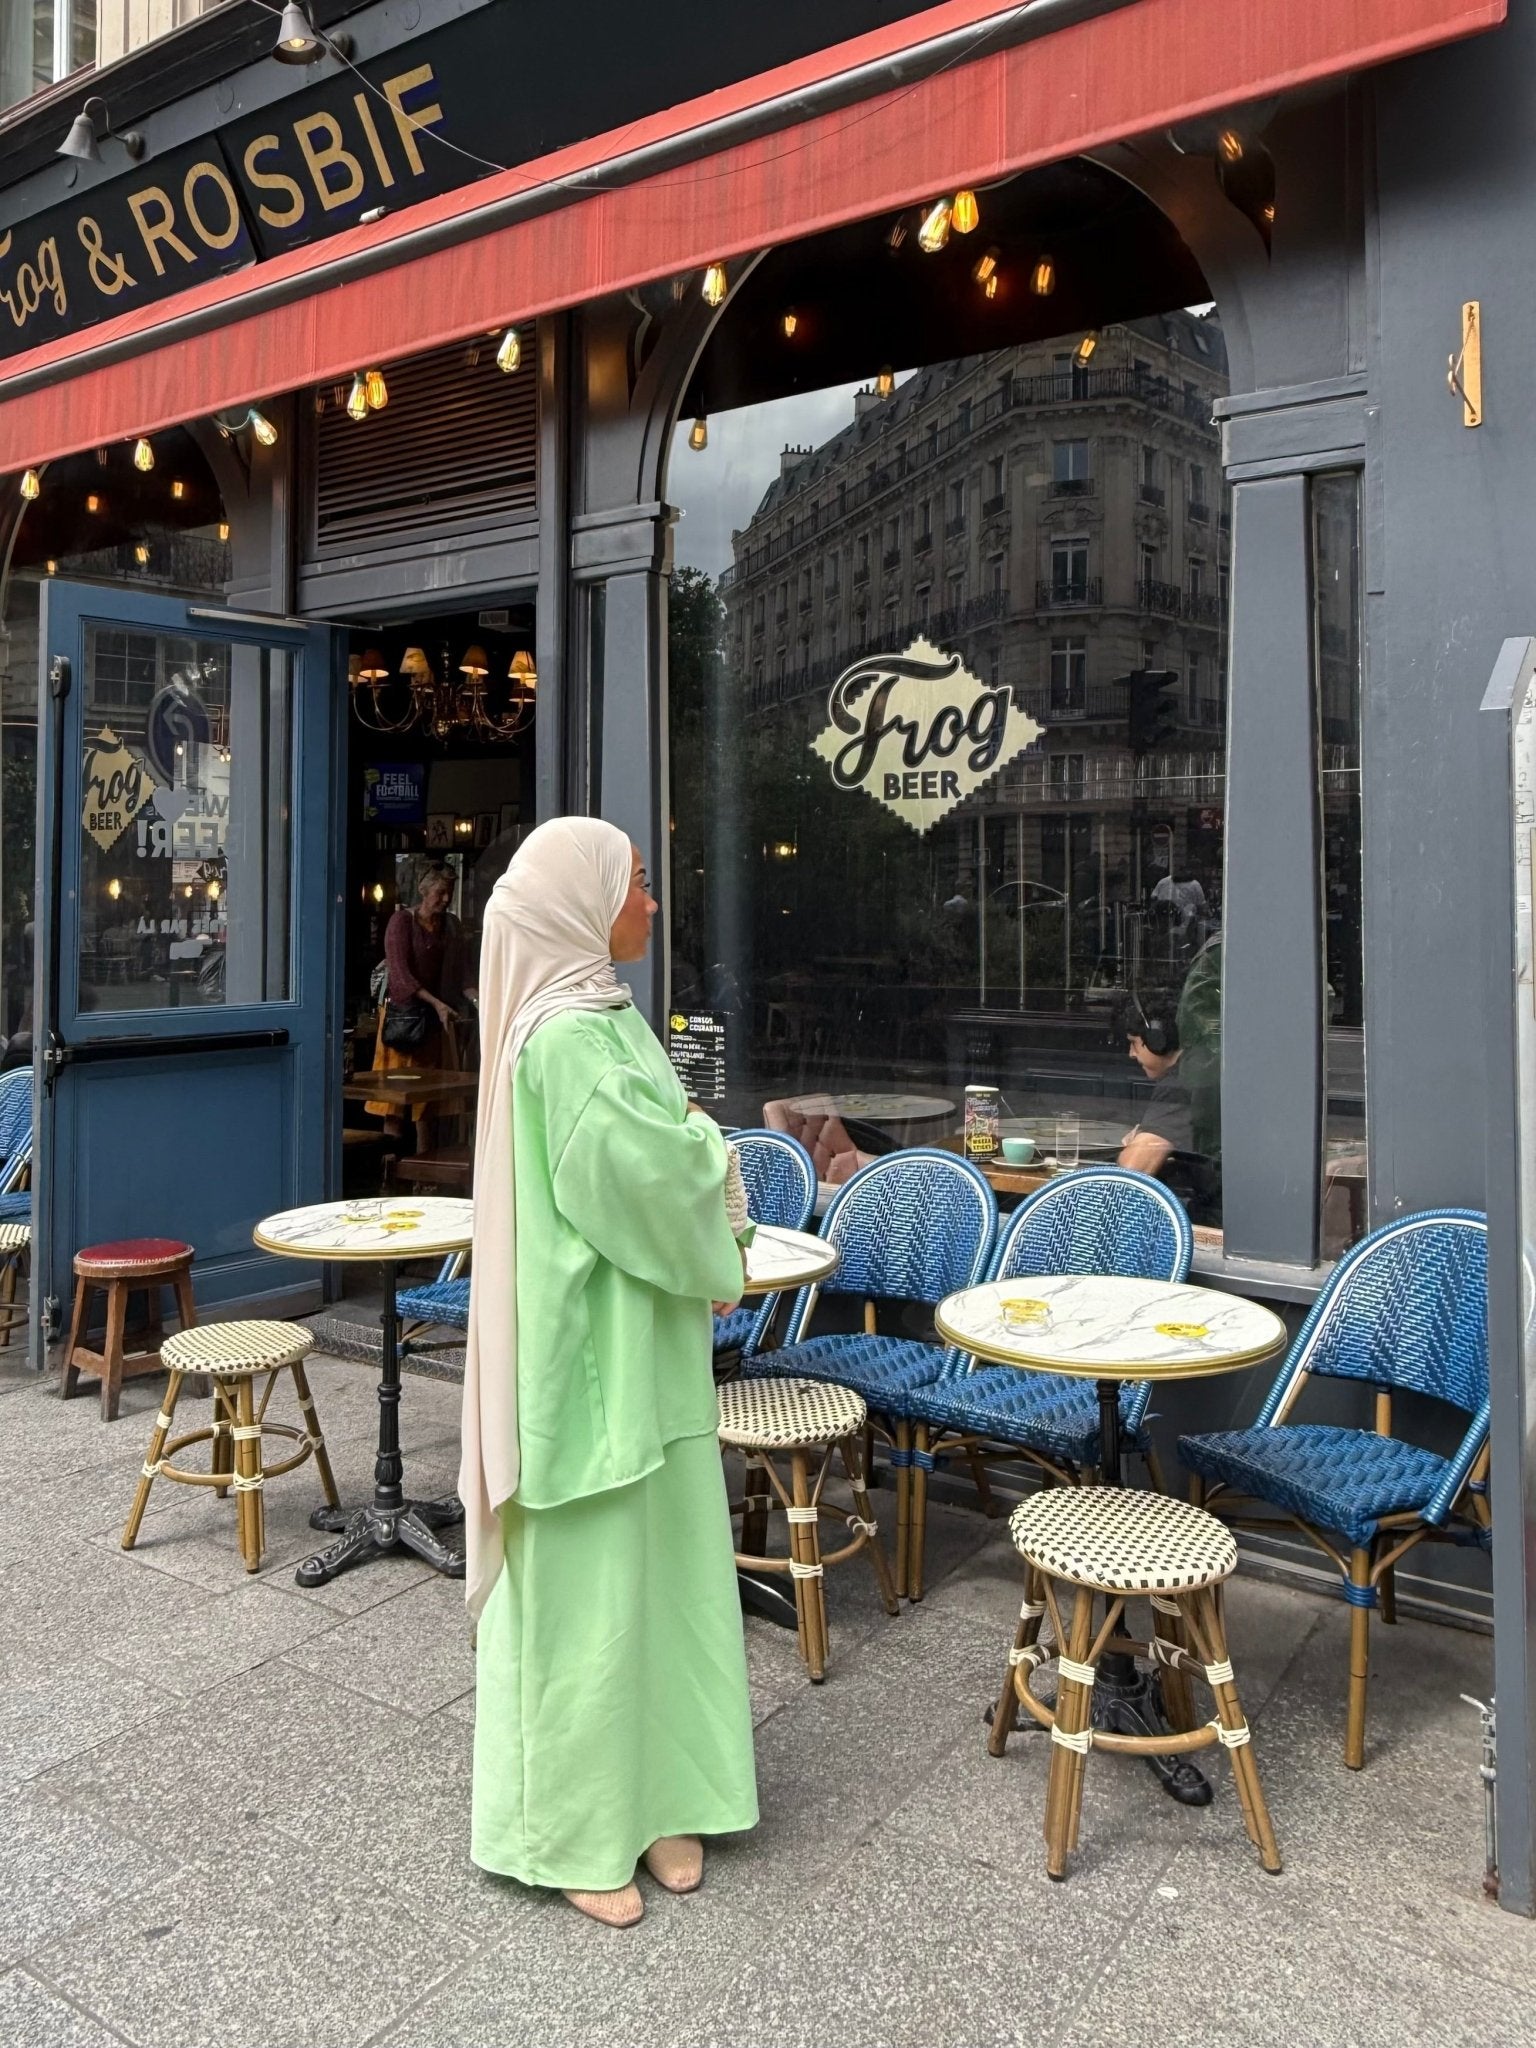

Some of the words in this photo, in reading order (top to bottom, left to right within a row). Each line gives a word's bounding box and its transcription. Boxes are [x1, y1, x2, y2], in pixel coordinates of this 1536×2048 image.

[0, 230, 68, 327] rog
[77, 216, 138, 296] &
[127, 63, 443, 277] ROSBIF
[830, 654, 1013, 788] Frog
[383, 773, 413, 785] FEEL
[883, 770, 962, 801] BEER
[89, 811, 123, 831] BEER
